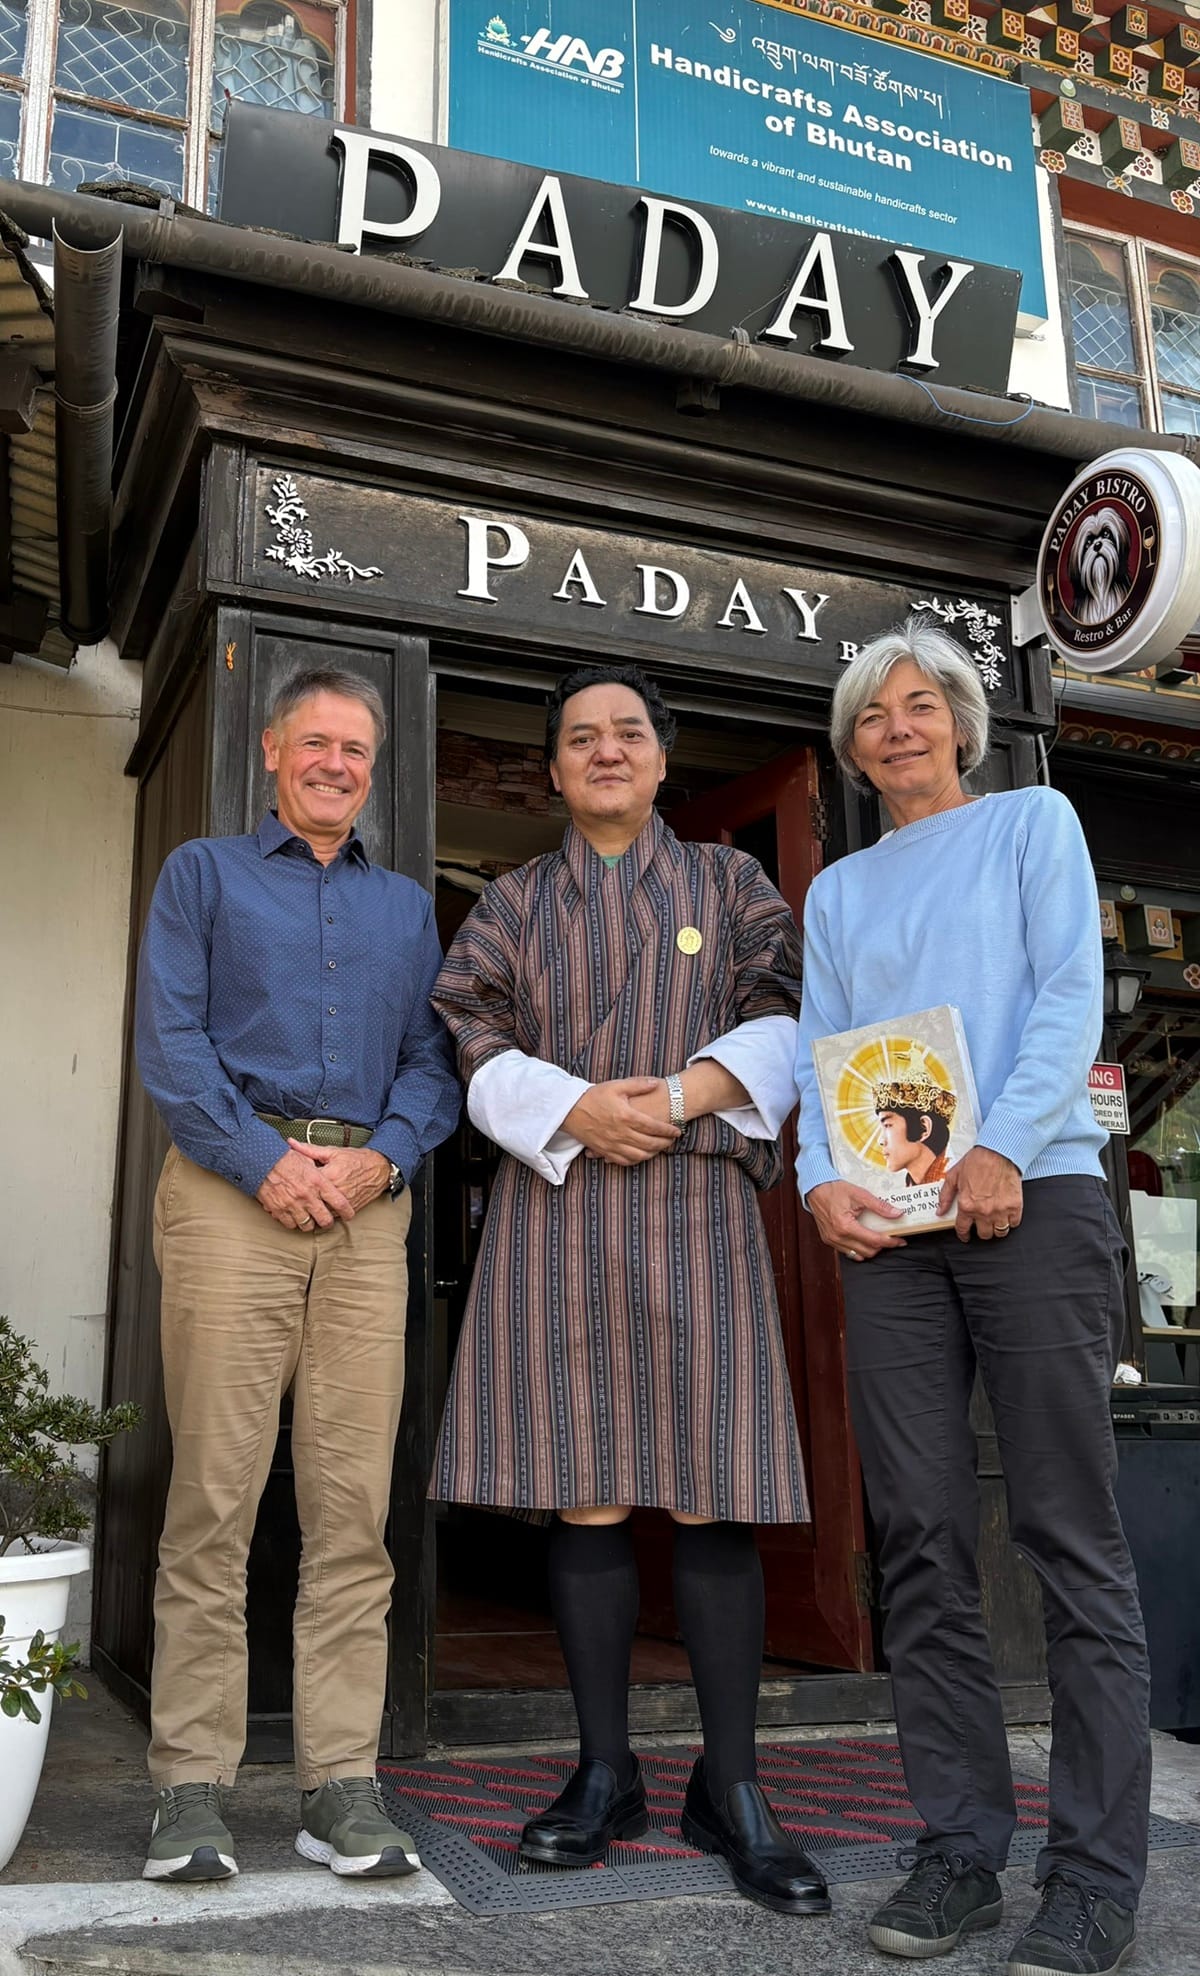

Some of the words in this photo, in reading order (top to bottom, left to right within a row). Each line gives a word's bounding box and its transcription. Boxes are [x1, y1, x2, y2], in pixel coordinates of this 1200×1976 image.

[477, 46, 528, 66] Handicrafts
[529, 63, 579, 82] Association
[580, 77, 589, 85] of
[591, 80, 621, 95] Bhutan
[520, 27, 625, 79] HAB
[650, 43, 833, 118] Handicrafts
[842, 103, 1013, 173] Association
[764, 115, 796, 137] of
[806, 121, 912, 172] Bhutan
[709, 144, 750, 165] towards
[751, 158, 759, 168] a
[761, 161, 795, 179] vibrant
[796, 171, 816, 184] and
[818, 177, 873, 201] sustainable
[874, 192, 927, 216] handicrafts
[928, 208, 958, 225] sector
[332, 130, 973, 369] PADAY
[1050, 487, 1090, 552] PADAY
[1095, 477, 1147, 513] BISTRO
[457, 515, 830, 643] PADAY
[1073, 627, 1105, 643] Restro
[1105, 623, 1114, 636] &
[1115, 608, 1133, 627] Bar
[1090, 1093, 1122, 1107] HOURS
[1094, 1109, 1112, 1118] ORED
[1113, 1111, 1123, 1119] BY
[1096, 1120, 1125, 1128] AMERAS
[890, 1194, 912, 1203] Song
[913, 1189, 923, 1200] of
[929, 1187, 941, 1197] Ki
[918, 1203, 927, 1211] 70
[928, 1201, 941, 1210] No
